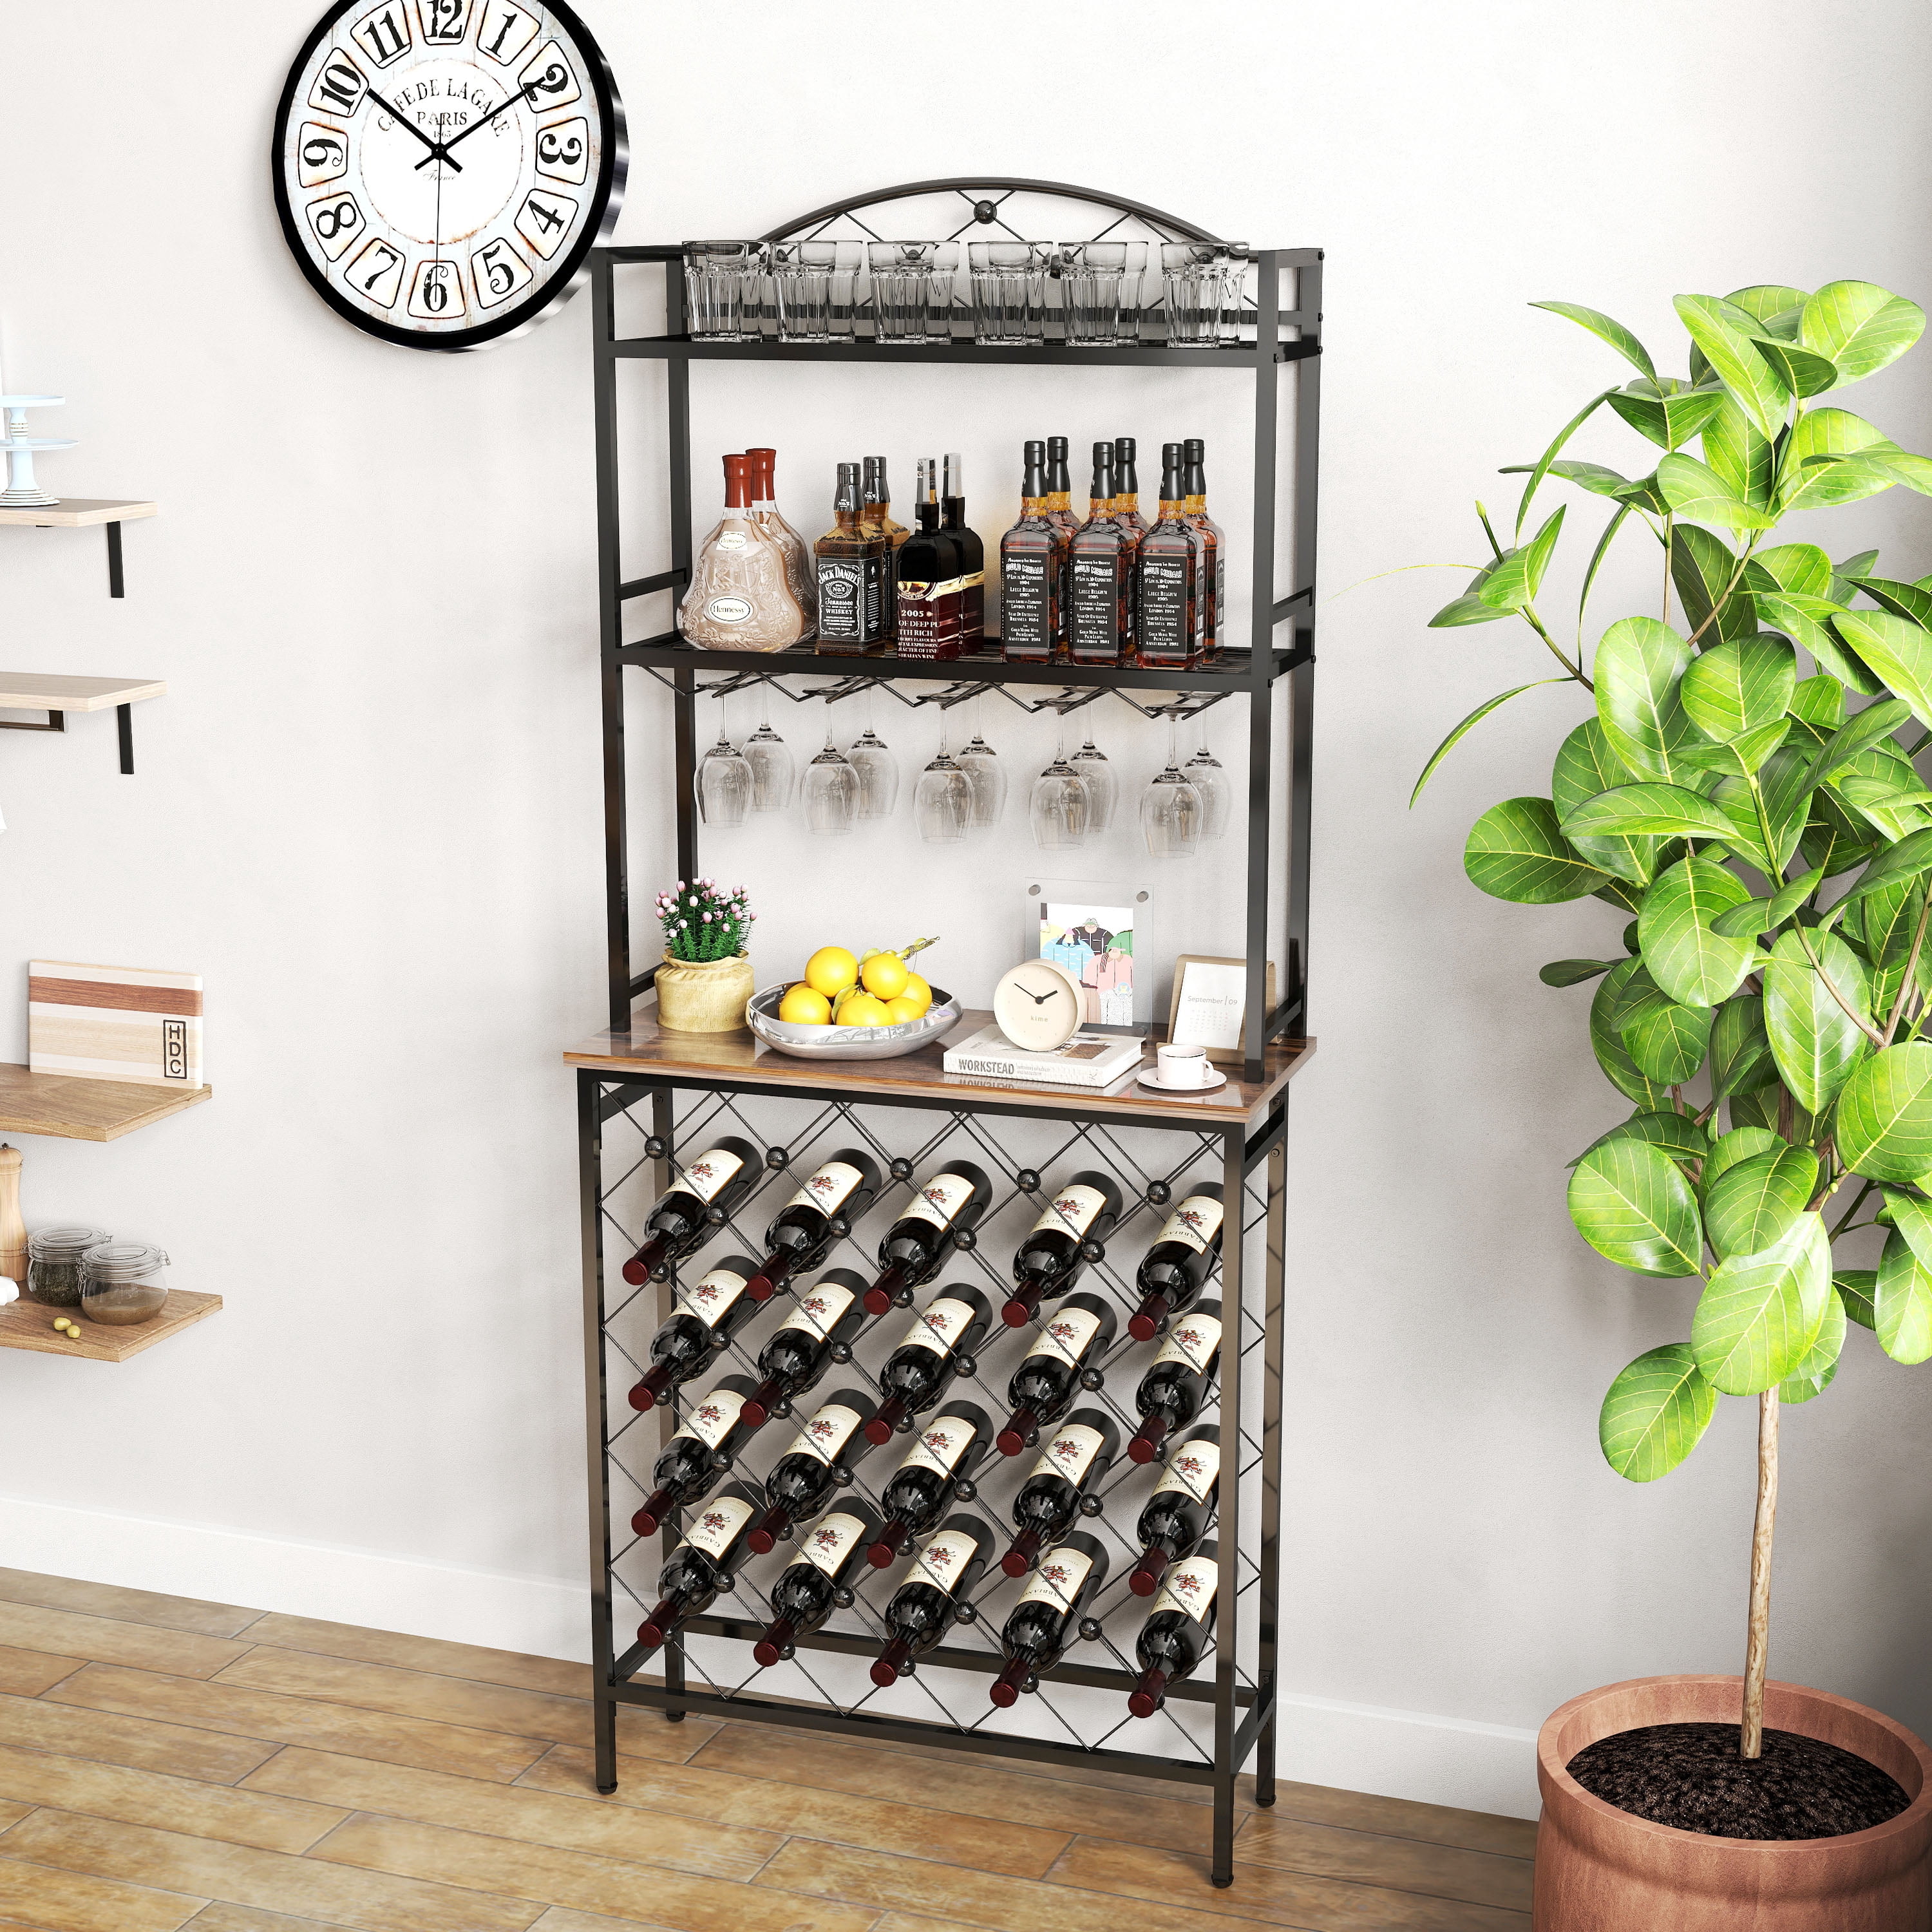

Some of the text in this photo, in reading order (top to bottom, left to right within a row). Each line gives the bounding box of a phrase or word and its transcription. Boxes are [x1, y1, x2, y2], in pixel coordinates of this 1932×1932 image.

[364, 10, 410, 64] 11
[425, 0, 462, 38] 12
[486, 13, 517, 59] 1
[319, 64, 362, 115] 10
[416, 79, 440, 100] DE
[447, 79, 468, 100] LA
[524, 63, 568, 102] 2
[417, 111, 468, 126] PARIS
[303, 138, 343, 167] 9
[538, 133, 582, 165] 3
[316, 202, 357, 240] 8
[529, 199, 565, 234] 4
[365, 246, 398, 290] 7
[482, 244, 515, 294] 5
[424, 265, 448, 312] 6
[818, 569, 835, 584] JACK
[1188, 996, 1224, 1005] September
[958, 1058, 1015, 1075] WORKSTEAD
